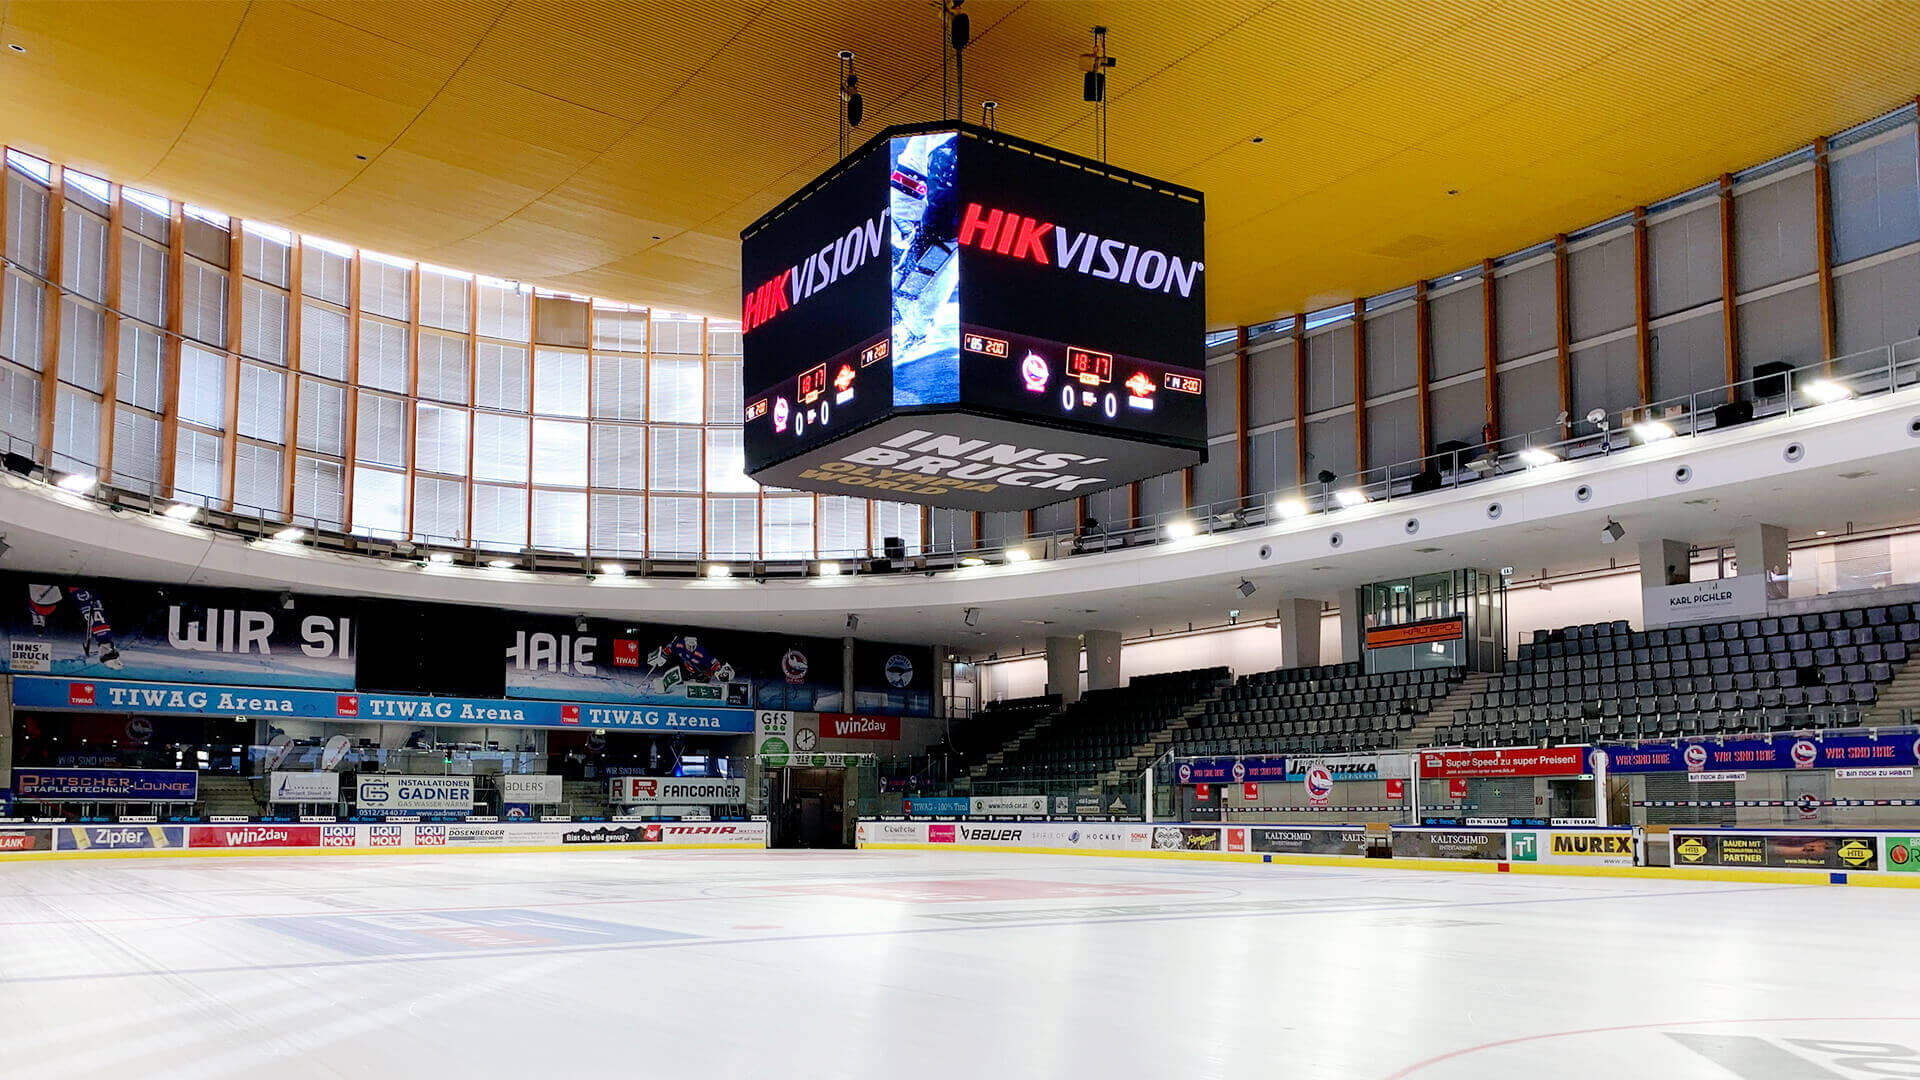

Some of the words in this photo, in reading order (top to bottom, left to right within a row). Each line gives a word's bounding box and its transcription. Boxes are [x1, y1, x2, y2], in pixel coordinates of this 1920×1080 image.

[958, 203, 1199, 297] HIKVISION
[742, 208, 887, 335] HIKVISION
[840, 446, 1106, 492] BRUCK
[820, 461, 999, 493] OLYMPIA
[798, 473, 949, 495] WORLD
[1670, 596, 1692, 605] KARL
[1693, 591, 1733, 603] PICHLER
[168, 605, 274, 655] WIR
[12, 650, 49, 661] BRUCK
[616, 656, 637, 665] TIWAG
[110, 688, 208, 709] TIWAG
[217, 694, 294, 713] Arena
[370, 700, 452, 718] TIWAG
[460, 704, 525, 721] Arena
[590, 709, 659, 725] TIWAG
[666, 712, 721, 728] Arena
[761, 712, 788, 725] GfS
[835, 717, 886, 736] win2day
[1714, 752, 1732, 762] WIR
[1825, 747, 1846, 759] WIR
[1446, 759, 1471, 768] Super
[1471, 758, 1498, 767] Speed
[1513, 757, 1537, 766] super
[1540, 755, 1576, 764] Preisen!
[398, 779, 470, 787] INSTALLATIONEN
[398, 788, 470, 800] GADNER
[664, 785, 741, 798] FANCORNER
[226, 827, 288, 846] win2day
[323, 827, 356, 836] LIQUI
[370, 827, 402, 836] LIQUI
[415, 827, 446, 836] LIQUI
[581, 833, 590, 841] du
[591, 833, 604, 841] wild
[1265, 832, 1311, 841] KALTSCHMID
[95, 829, 145, 848] Zipfer
[323, 836, 356, 846] MOLY
[370, 836, 402, 846] MOLY
[415, 836, 446, 846] MOLY
[1431, 835, 1489, 844] KALTSCHMID
[1723, 840, 1747, 848] BAUEN
[1554, 837, 1632, 853] MUREX
[1724, 854, 1762, 863] PARTNER
